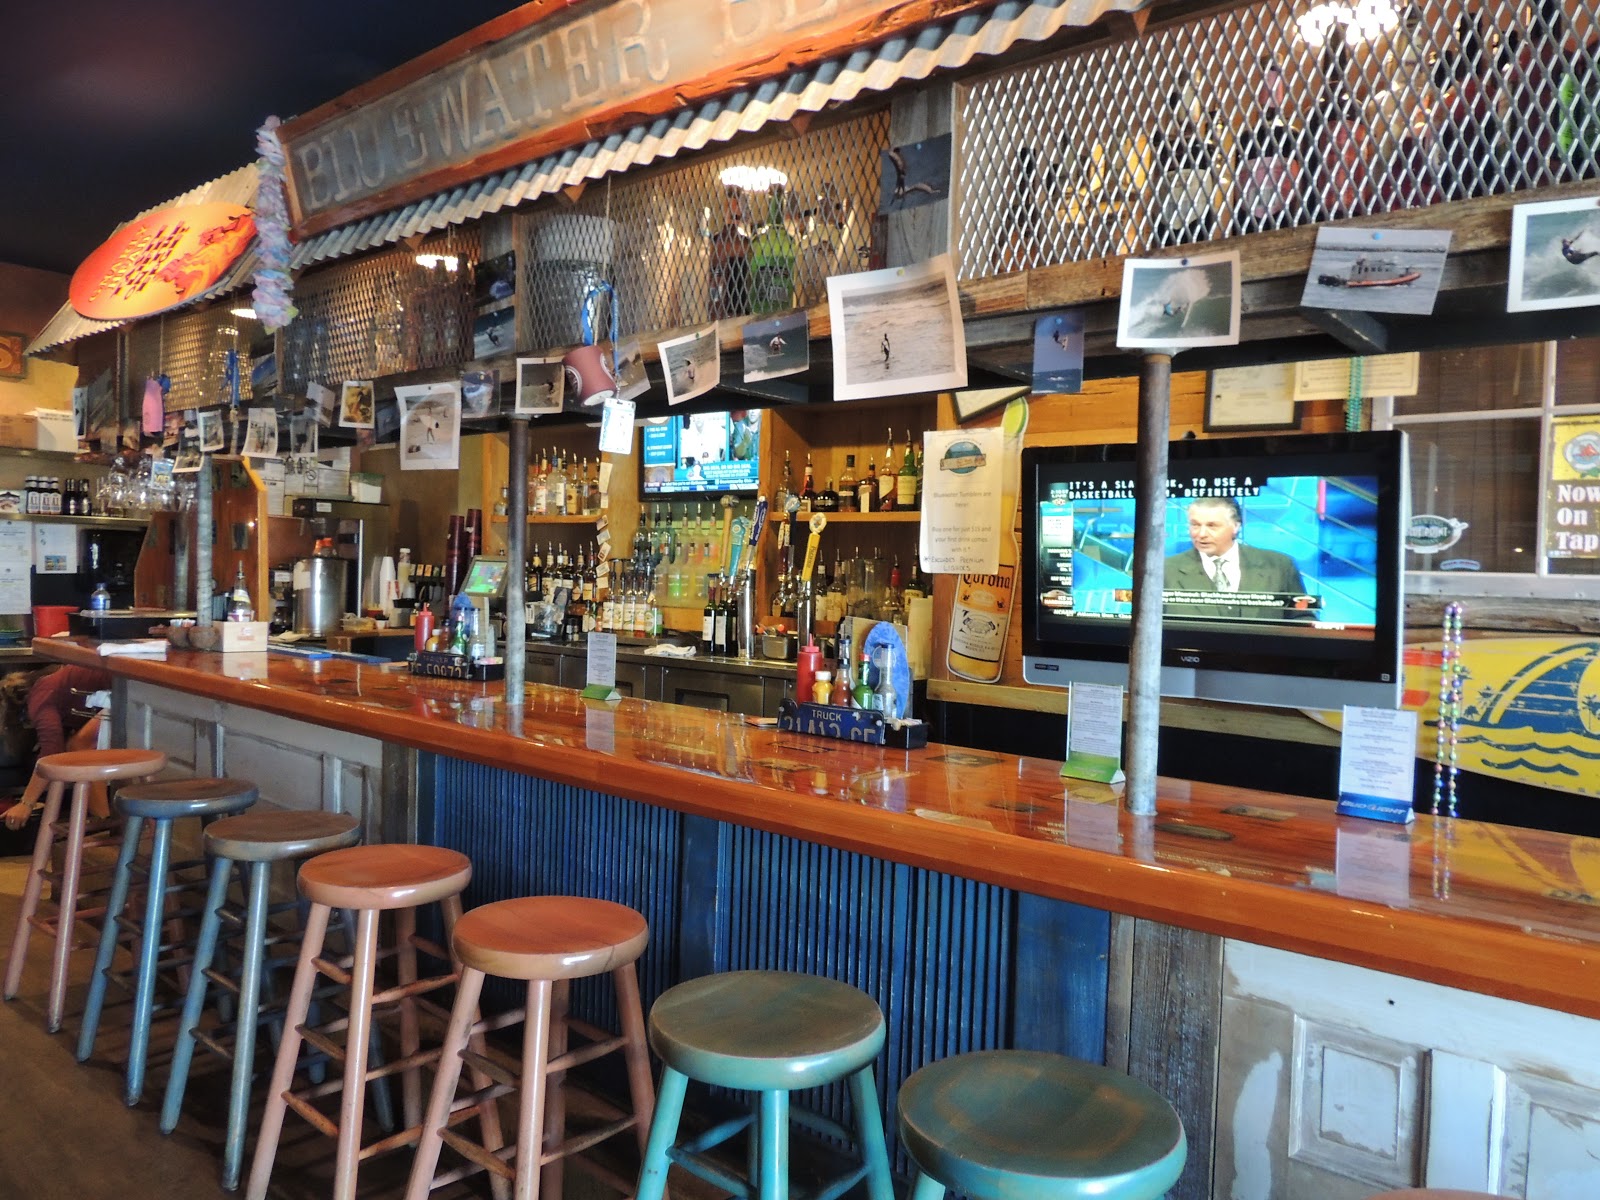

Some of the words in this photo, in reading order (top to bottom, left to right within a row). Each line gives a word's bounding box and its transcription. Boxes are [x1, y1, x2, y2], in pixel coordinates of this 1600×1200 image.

[107, 235, 152, 289] HEAD
[110, 224, 168, 298] TASTE
[1069, 481, 1095, 490] IT'S
[1101, 480, 1108, 489] A
[1114, 480, 1135, 489] SLA
[1192, 478, 1206, 487] TO
[1214, 477, 1236, 487] USE
[1244, 477, 1252, 486] A
[1069, 489, 1134, 499] BASKETBALL
[1184, 487, 1260, 497] DEFINITELY
[1558, 484, 1600, 503] Now
[1556, 507, 1588, 526] On
[1556, 531, 1599, 552] Tap
[963, 573, 1011, 589] Corona
[1180, 655, 1200, 663] VIZIO
[811, 709, 842, 722] TRUCK
